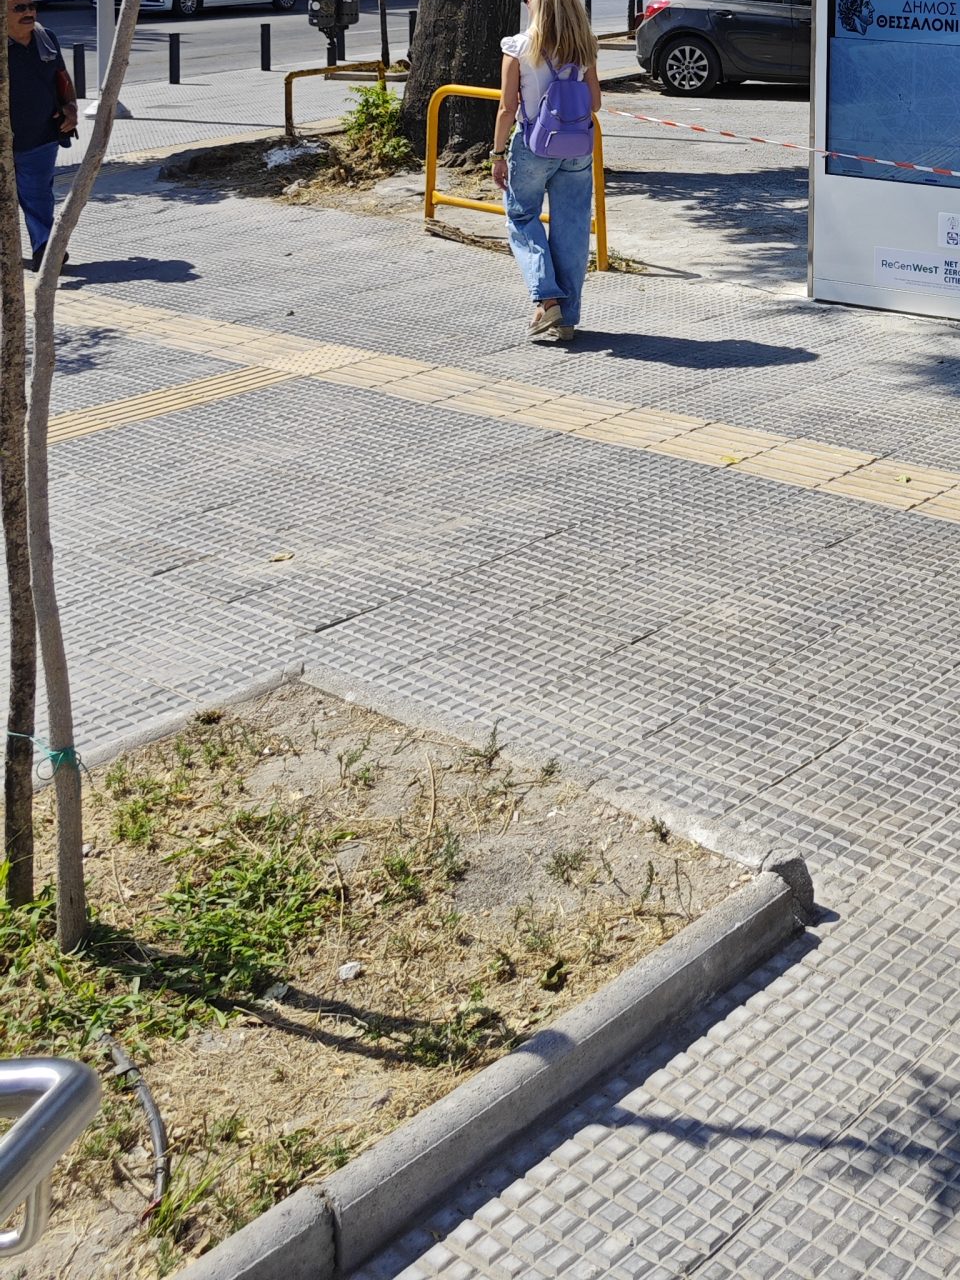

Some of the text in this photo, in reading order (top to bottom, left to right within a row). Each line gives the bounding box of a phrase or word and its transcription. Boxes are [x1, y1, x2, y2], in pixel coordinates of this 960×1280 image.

[902, 0, 957, 16] ΔΗΜΟΣ
[881, 259, 940, 275] ReGenWesT
[944, 260, 959, 268] NET
